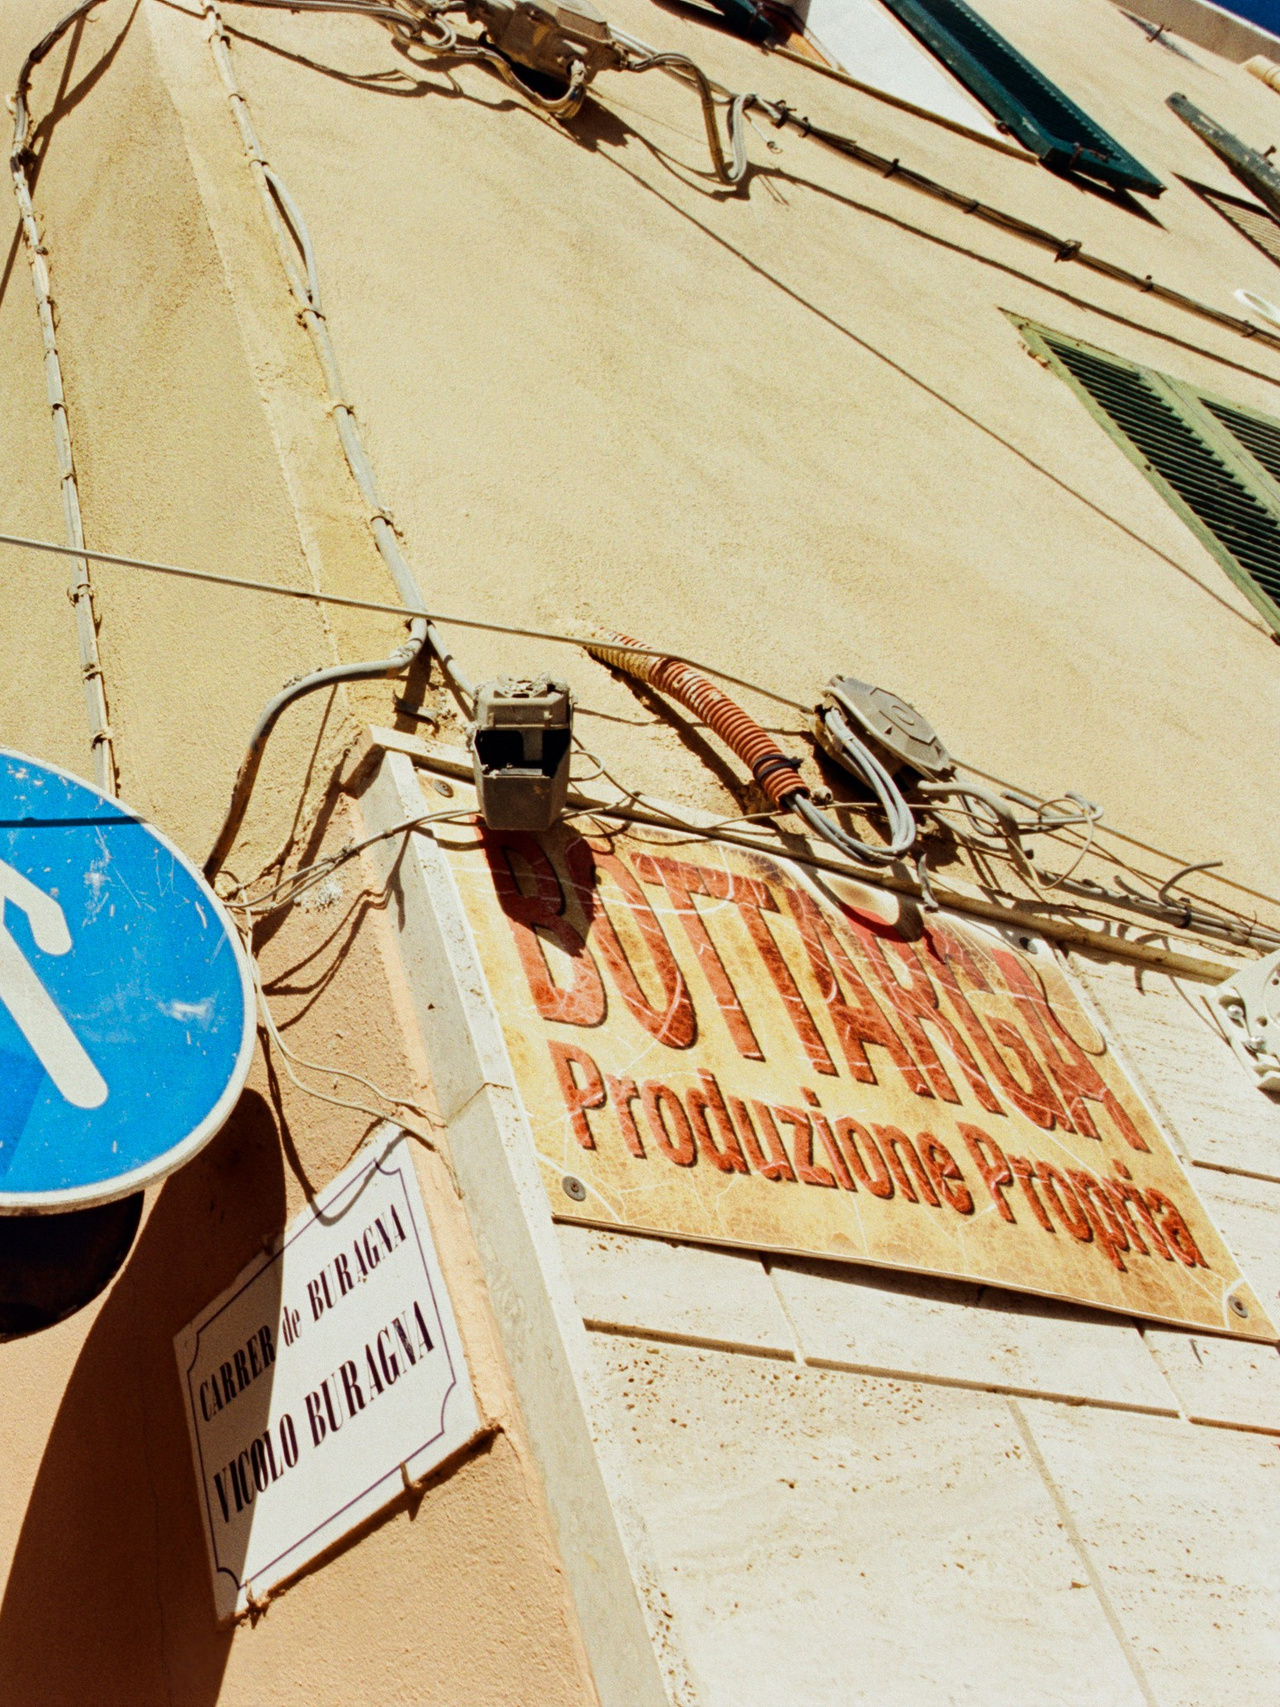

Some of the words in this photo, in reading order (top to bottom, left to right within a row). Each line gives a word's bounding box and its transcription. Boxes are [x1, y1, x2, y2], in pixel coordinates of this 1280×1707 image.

[472, 816, 1151, 1153] BOTTARGA
[548, 1040, 975, 1215] Produzione
[956, 1121, 1210, 1272] Propria
[199, 1325, 277, 1422] CARRER
[281, 1305, 303, 1348] de
[306, 1204, 407, 1322] BURAGNA
[212, 1414, 300, 1524] VICOLO
[303, 1300, 434, 1448] BURAGNA
